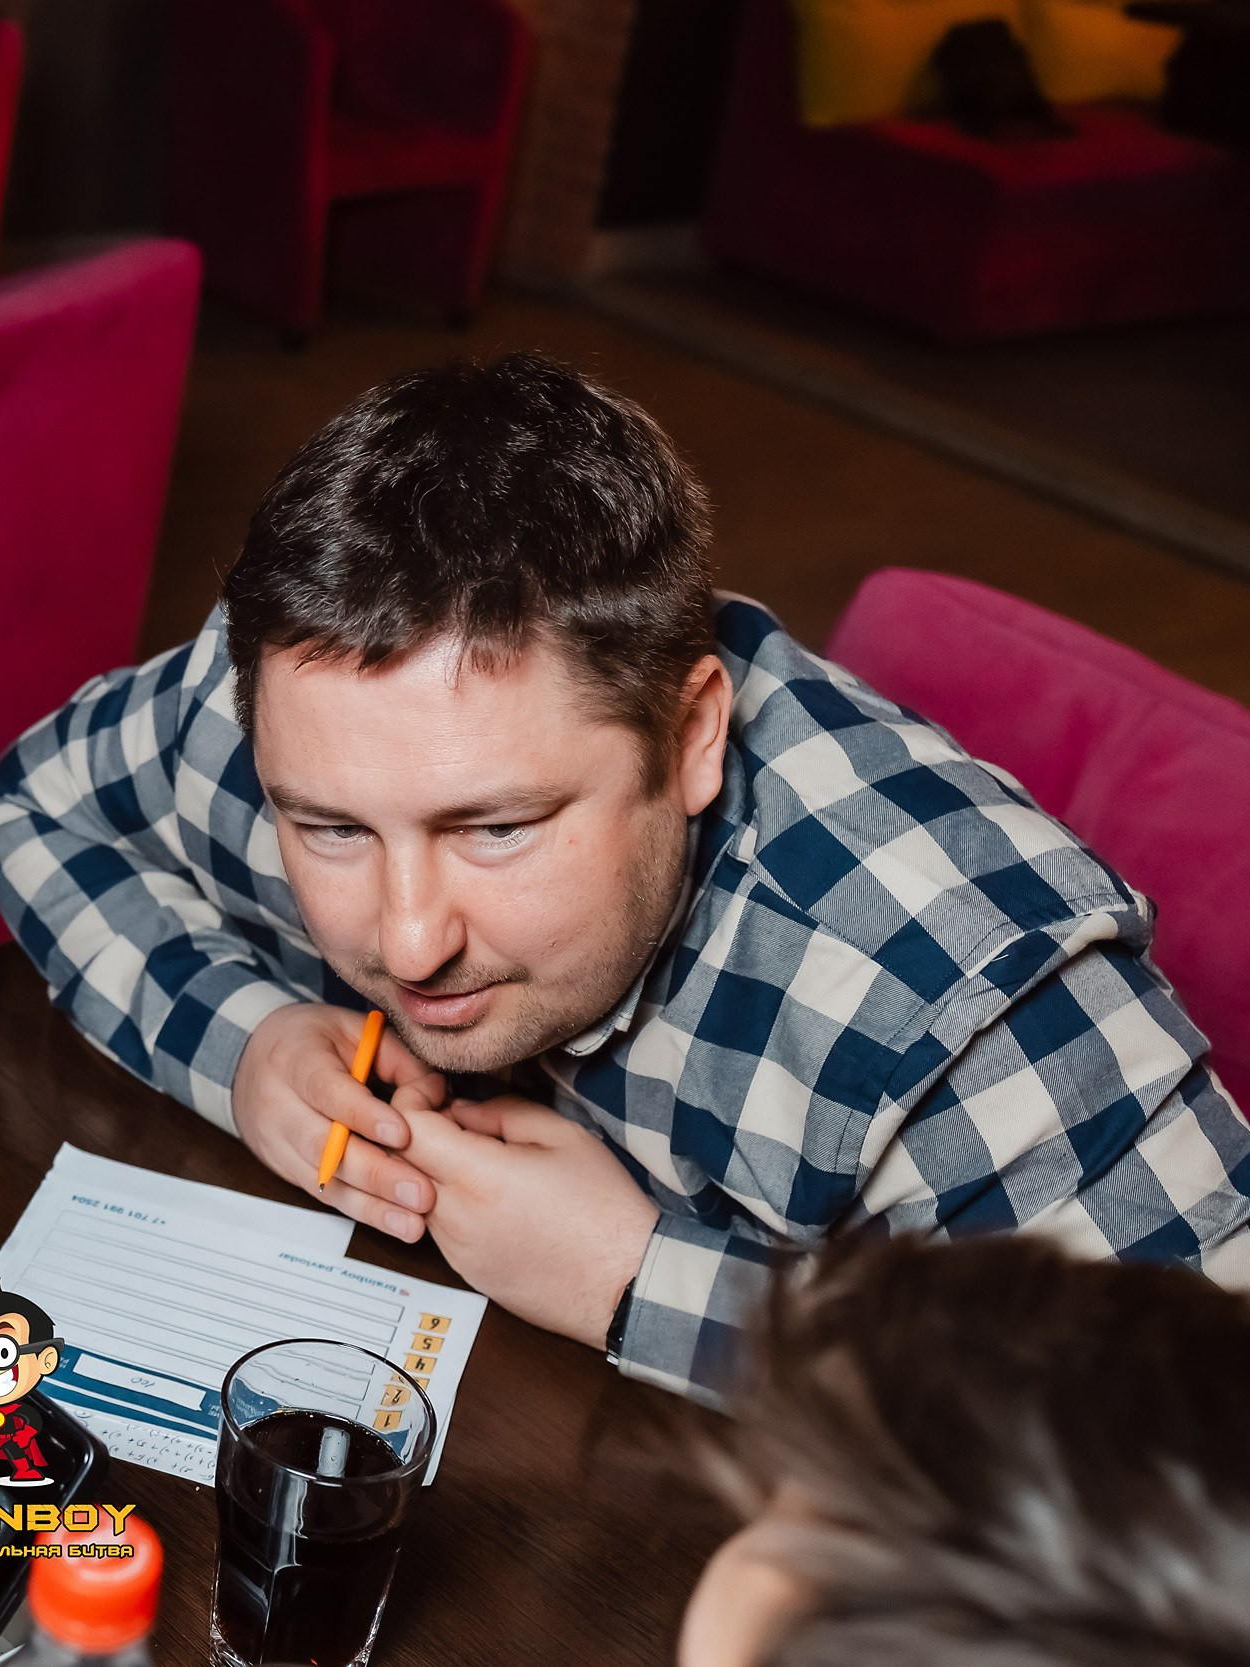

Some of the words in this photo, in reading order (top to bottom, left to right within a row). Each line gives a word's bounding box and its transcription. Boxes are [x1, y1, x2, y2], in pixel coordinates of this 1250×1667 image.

[429, 1317, 441, 1331] 6
[421, 1337, 433, 1351] 5
[414, 1357, 426, 1371] 4
[391, 1388, 403, 1406] 2
[383, 1413, 393, 1428] 1
